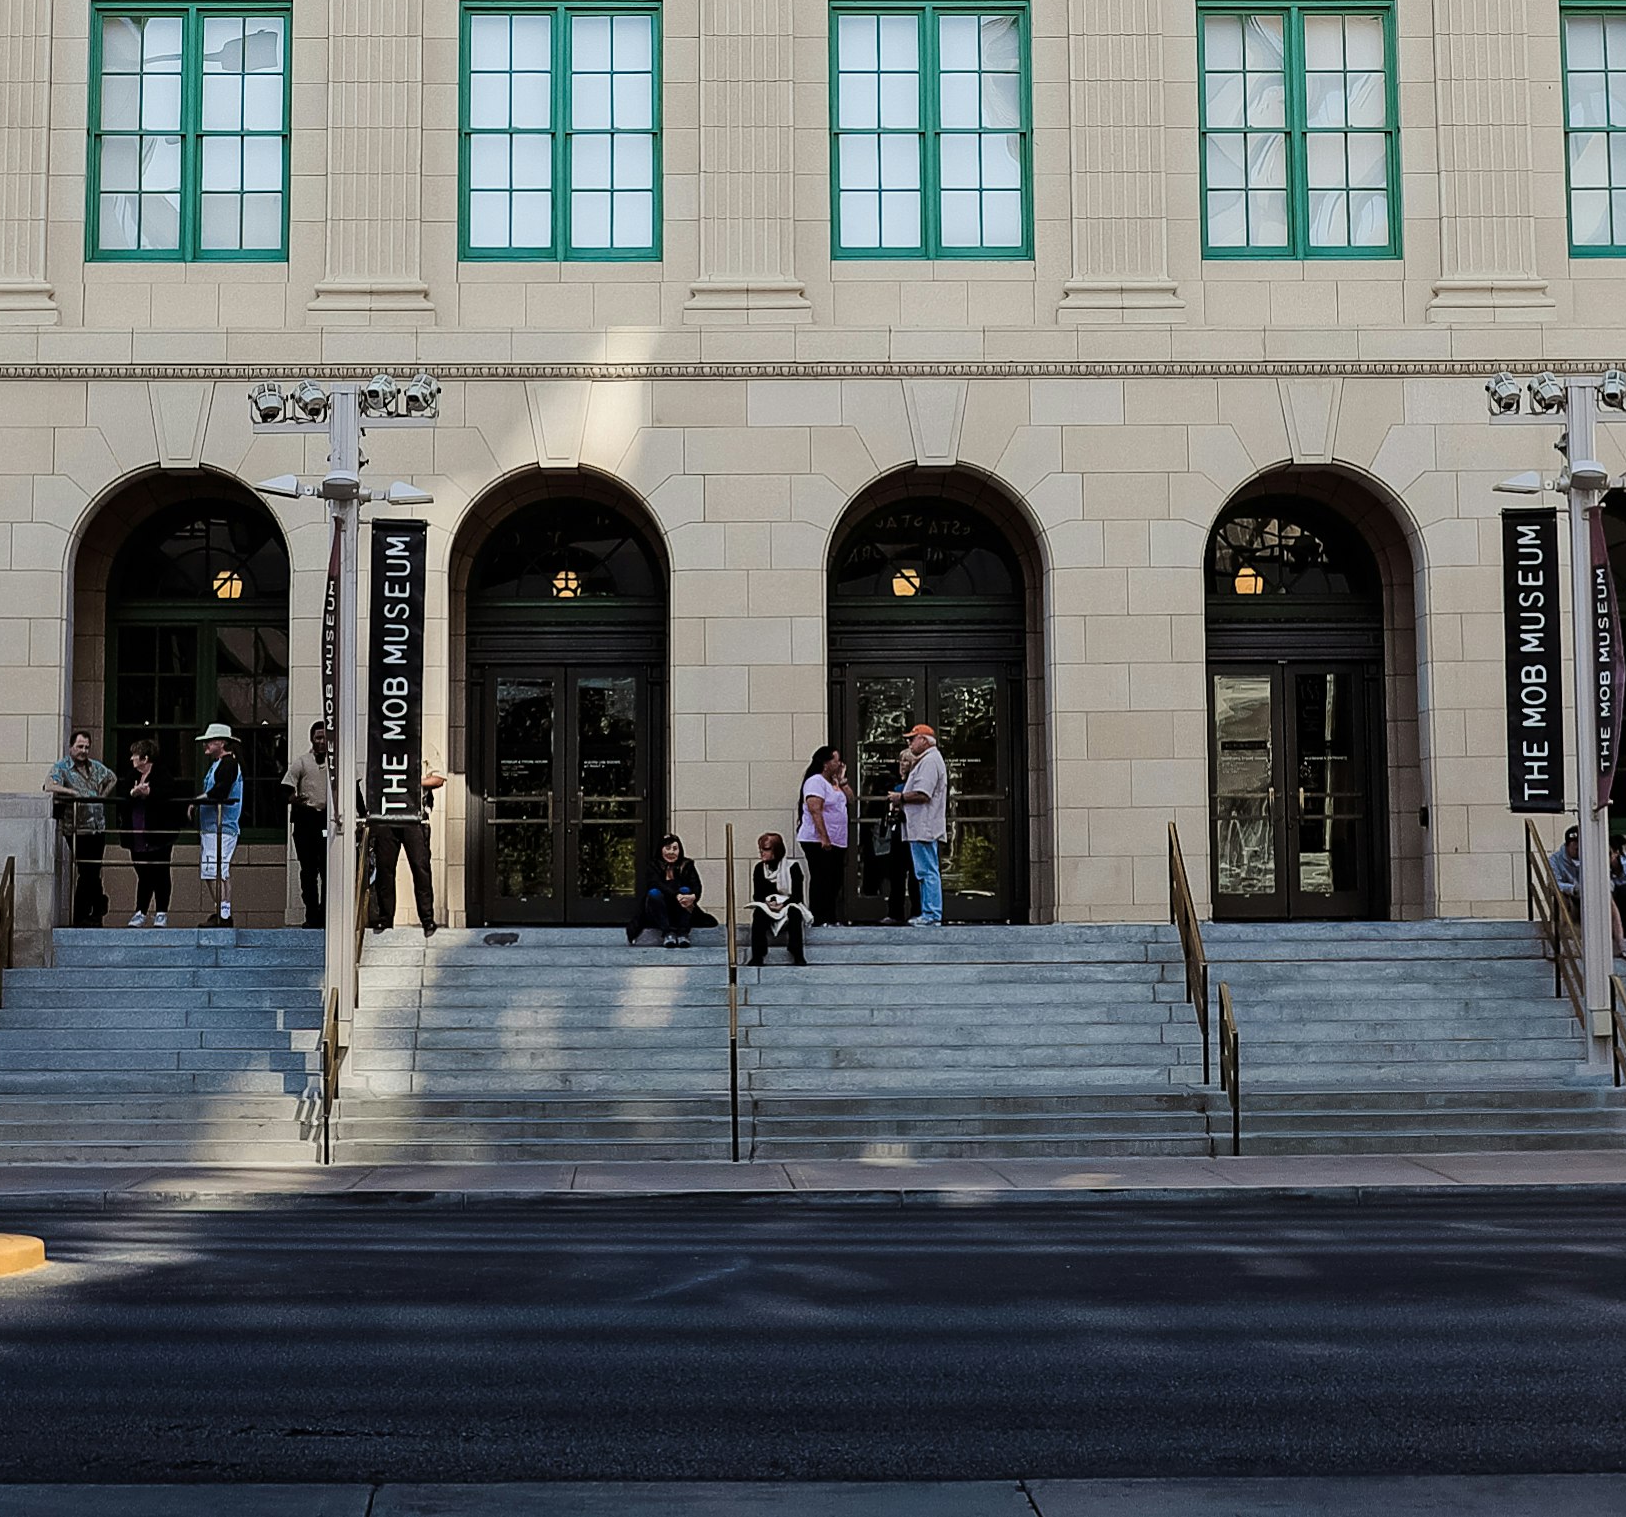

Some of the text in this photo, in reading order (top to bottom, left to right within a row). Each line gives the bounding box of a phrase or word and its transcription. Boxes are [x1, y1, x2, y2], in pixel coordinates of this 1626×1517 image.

[325, 580, 336, 676] MUSEUM
[326, 683, 334, 731] MOB
[381, 536, 411, 815] THE MOB MUSEUM
[1516, 525, 1549, 801] THE MOB MUSEUM
[1596, 568, 1612, 772] THE MOB MUSEUM
